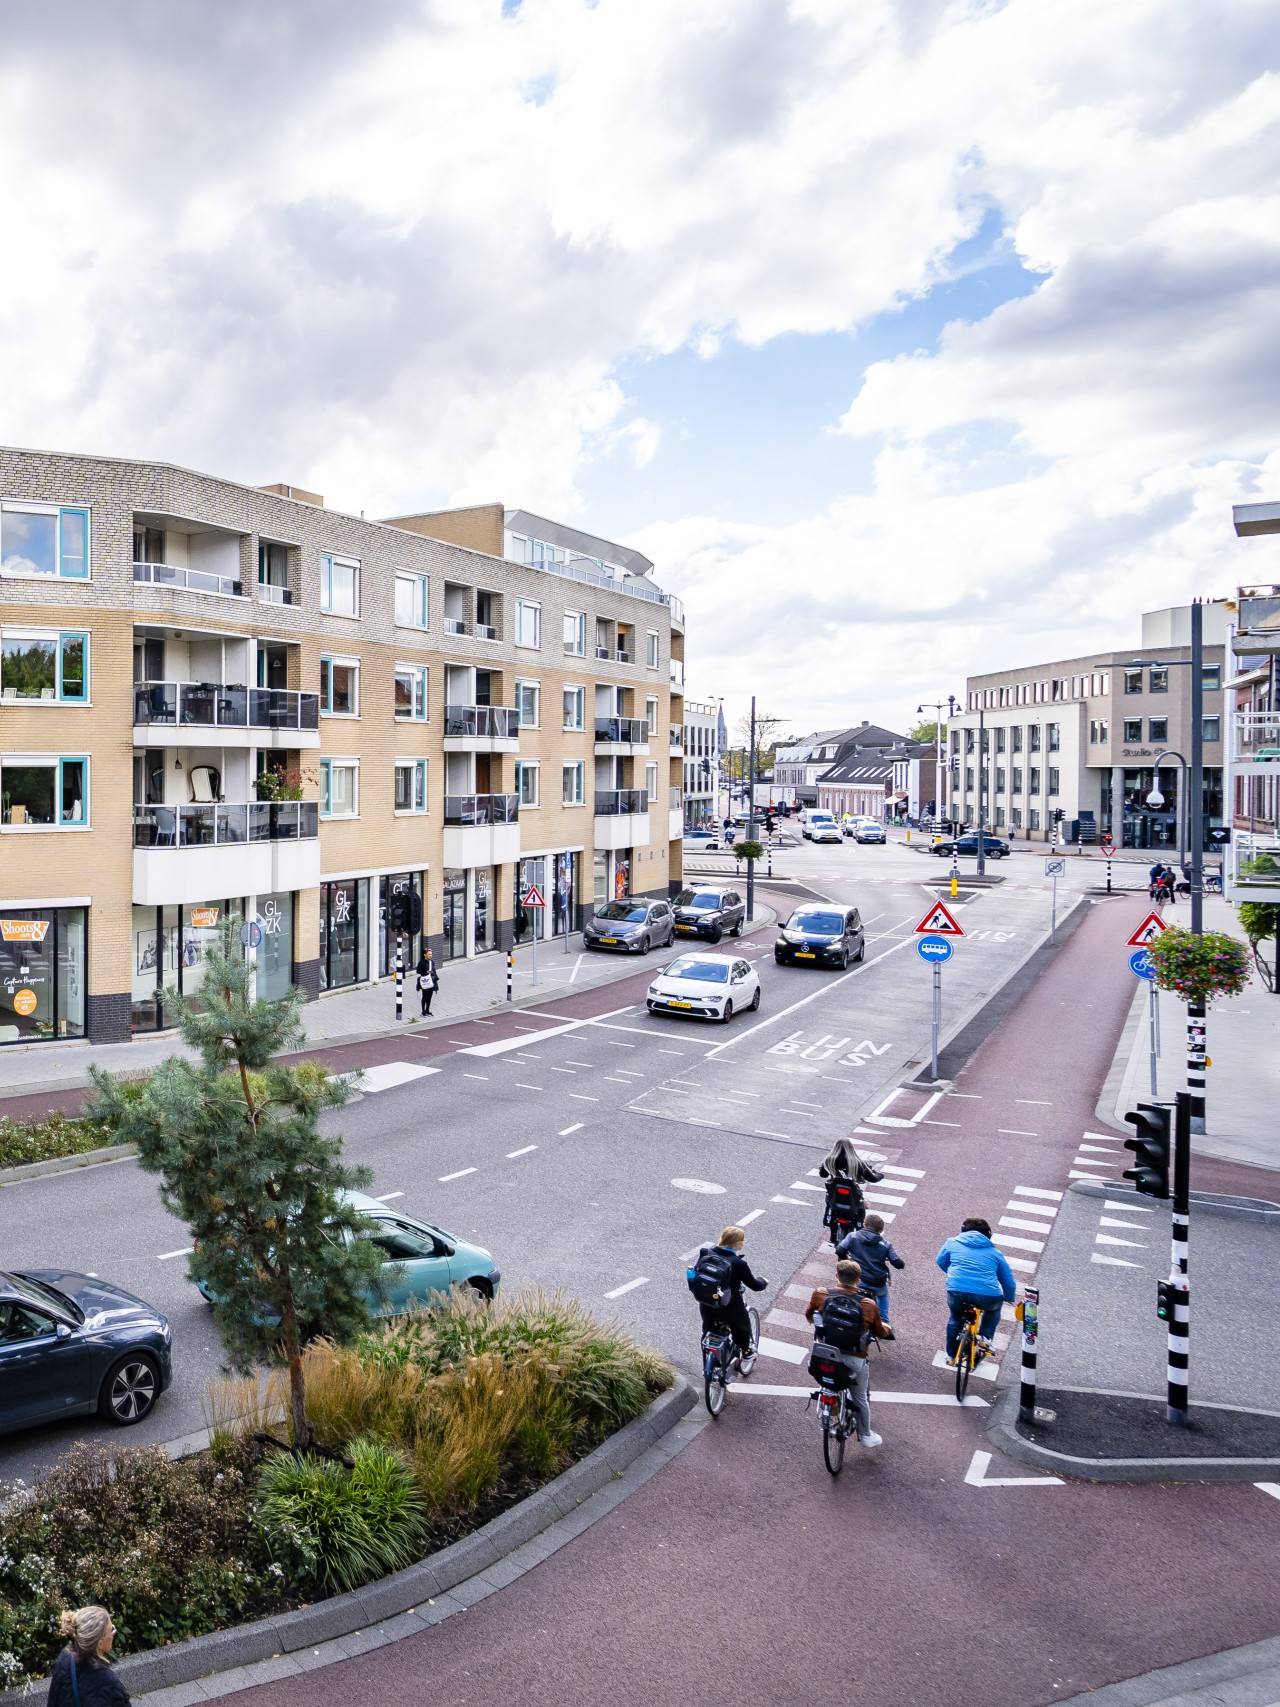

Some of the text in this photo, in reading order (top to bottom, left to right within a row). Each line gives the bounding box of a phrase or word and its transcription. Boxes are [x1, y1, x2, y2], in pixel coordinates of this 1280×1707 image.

[479, 871, 489, 884] GL
[335, 890, 350, 905] GL
[479, 885, 489, 898] ZK
[265, 901, 281, 916] GL
[336, 904, 350, 922] ZK
[265, 917, 281, 934] ZK
[783, 1030, 894, 1056] LIJN
[765, 1041, 873, 1067] BUS
